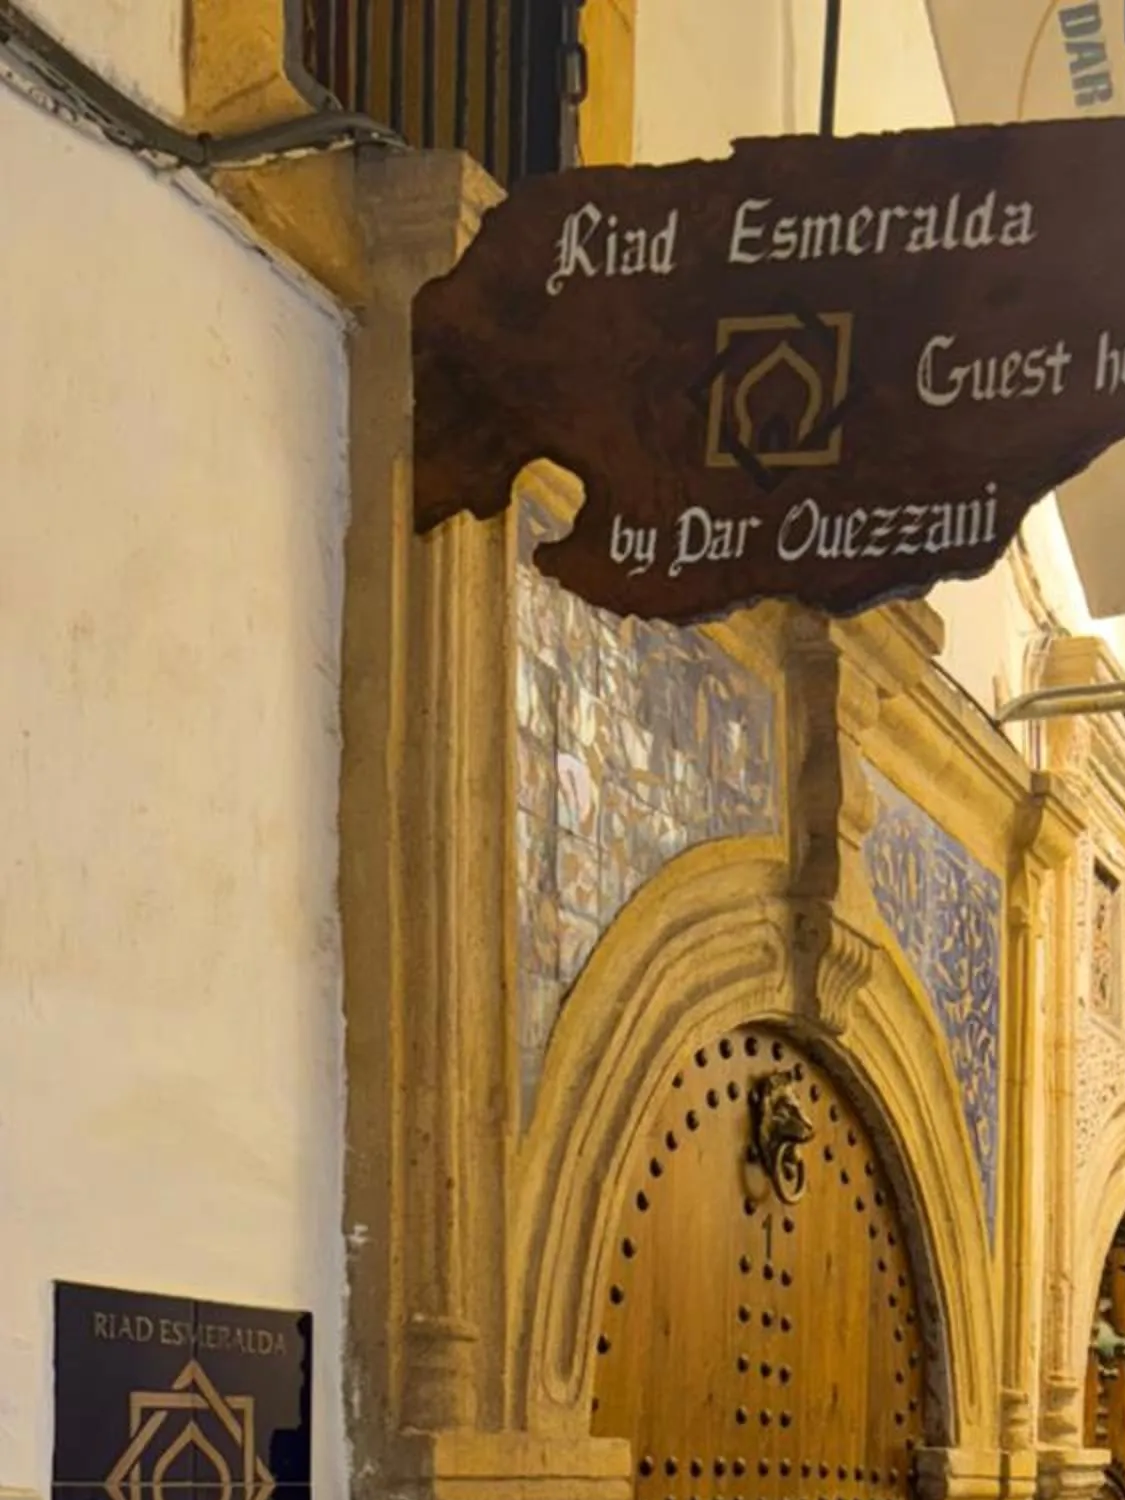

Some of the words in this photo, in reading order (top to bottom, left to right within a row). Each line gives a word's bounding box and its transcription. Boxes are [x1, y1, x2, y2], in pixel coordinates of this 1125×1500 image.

[1058, 2, 1113, 107] DAR
[546, 201, 680, 296] Riad
[729, 190, 1037, 263] Esmeralda
[917, 334, 1072, 407] Guest
[609, 514, 657, 577] by
[668, 506, 762, 577] Dar
[777, 482, 998, 561] Ouezzani
[93, 1311, 154, 1342] RIAD
